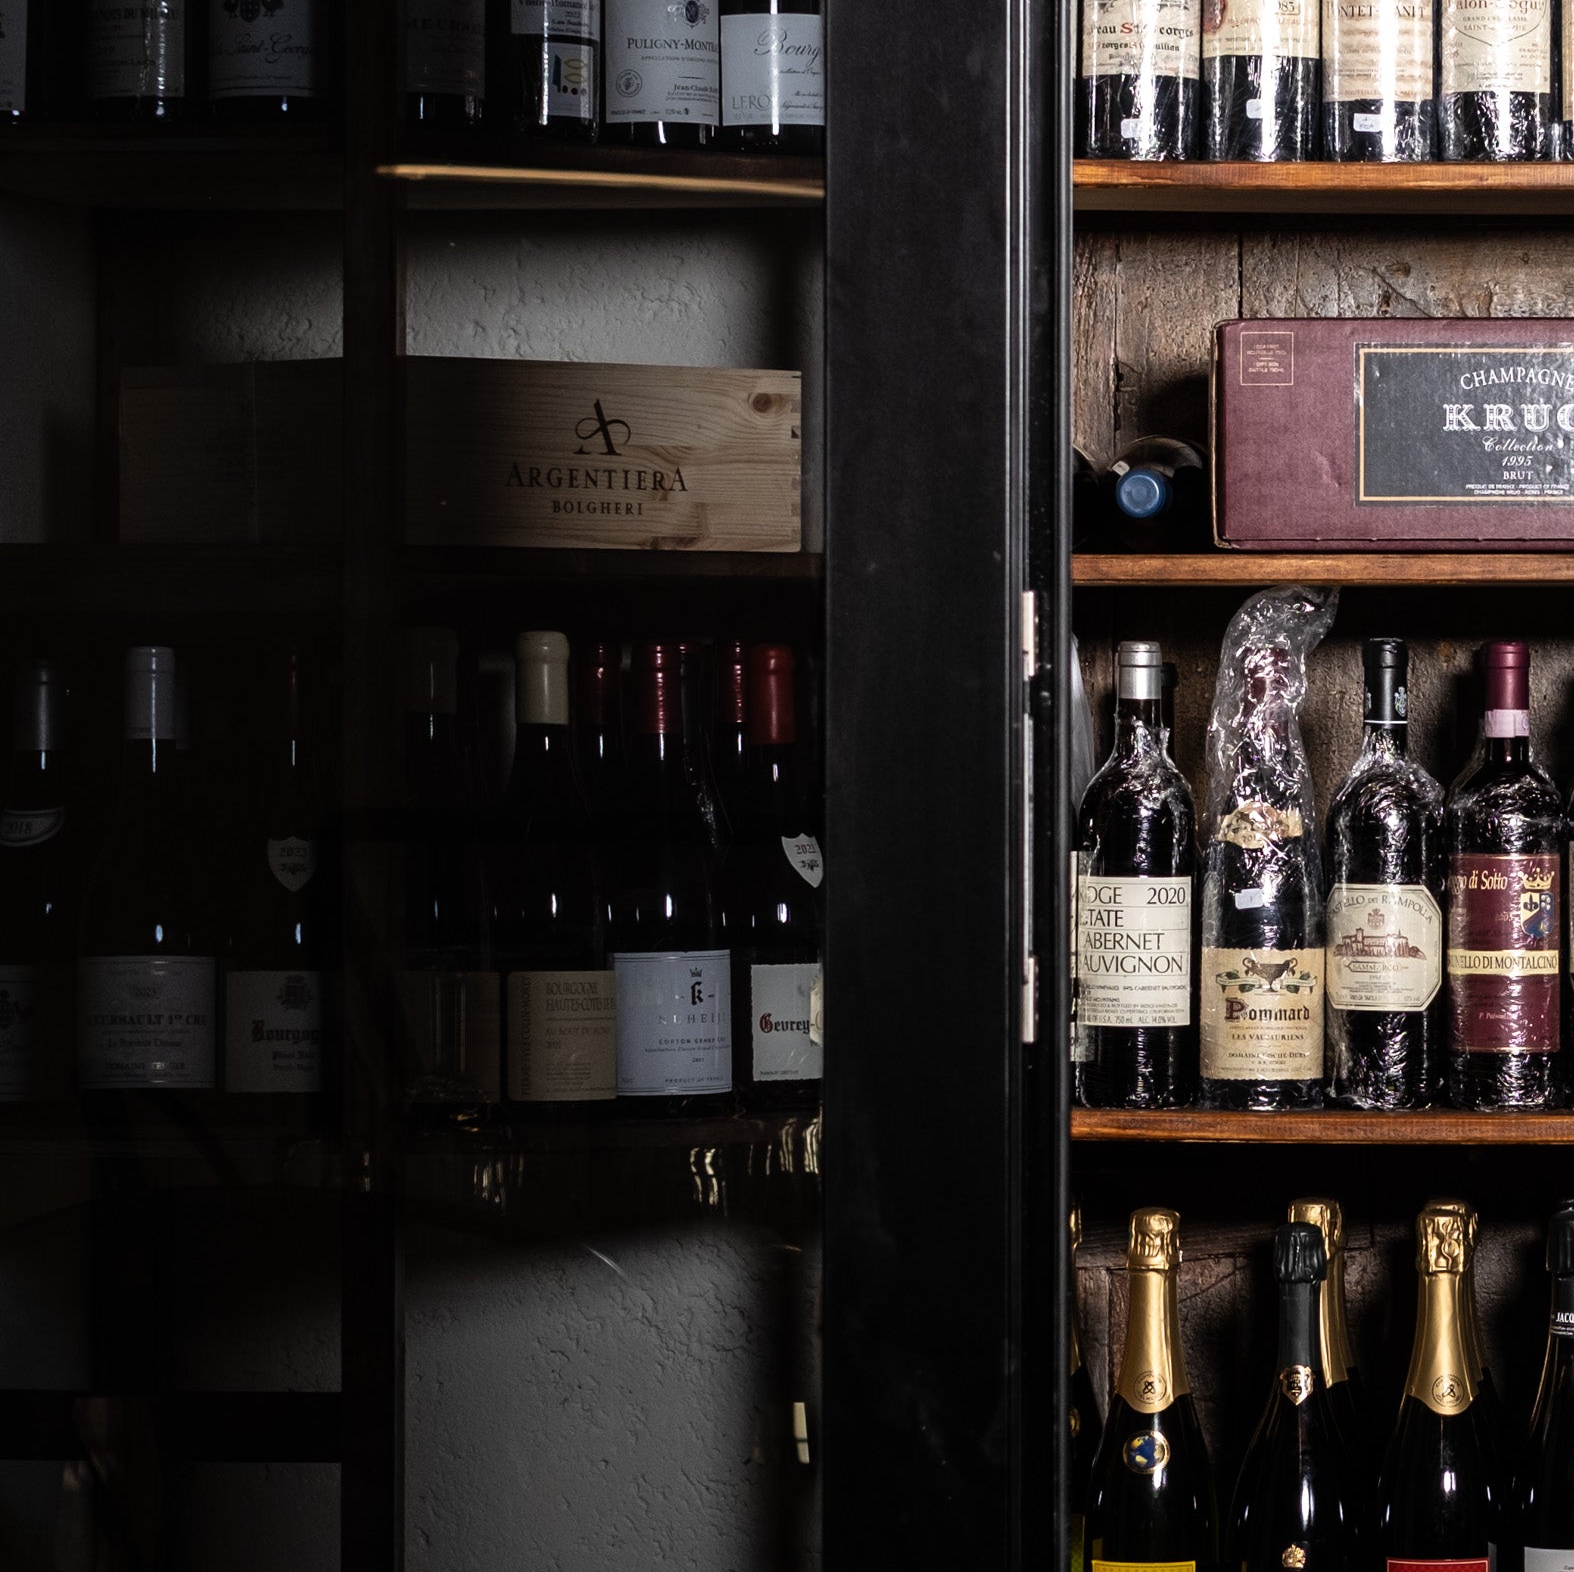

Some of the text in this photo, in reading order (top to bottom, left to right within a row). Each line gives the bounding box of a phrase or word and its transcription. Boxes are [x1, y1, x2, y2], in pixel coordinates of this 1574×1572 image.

[1482, 436, 1554, 453] Collection
[1500, 455, 1533, 467] 1995
[504, 462, 688, 491] ARGENTIERA
[1503, 471, 1534, 480] BRUT
[552, 500, 643, 515] BOLGHERI
[1469, 868, 1507, 890] di Sotto
[1147, 887, 1186, 904] 2020
[1483, 955, 1557, 969] DI MONTALCINO
[1225, 997, 1310, 1023] Pommard
